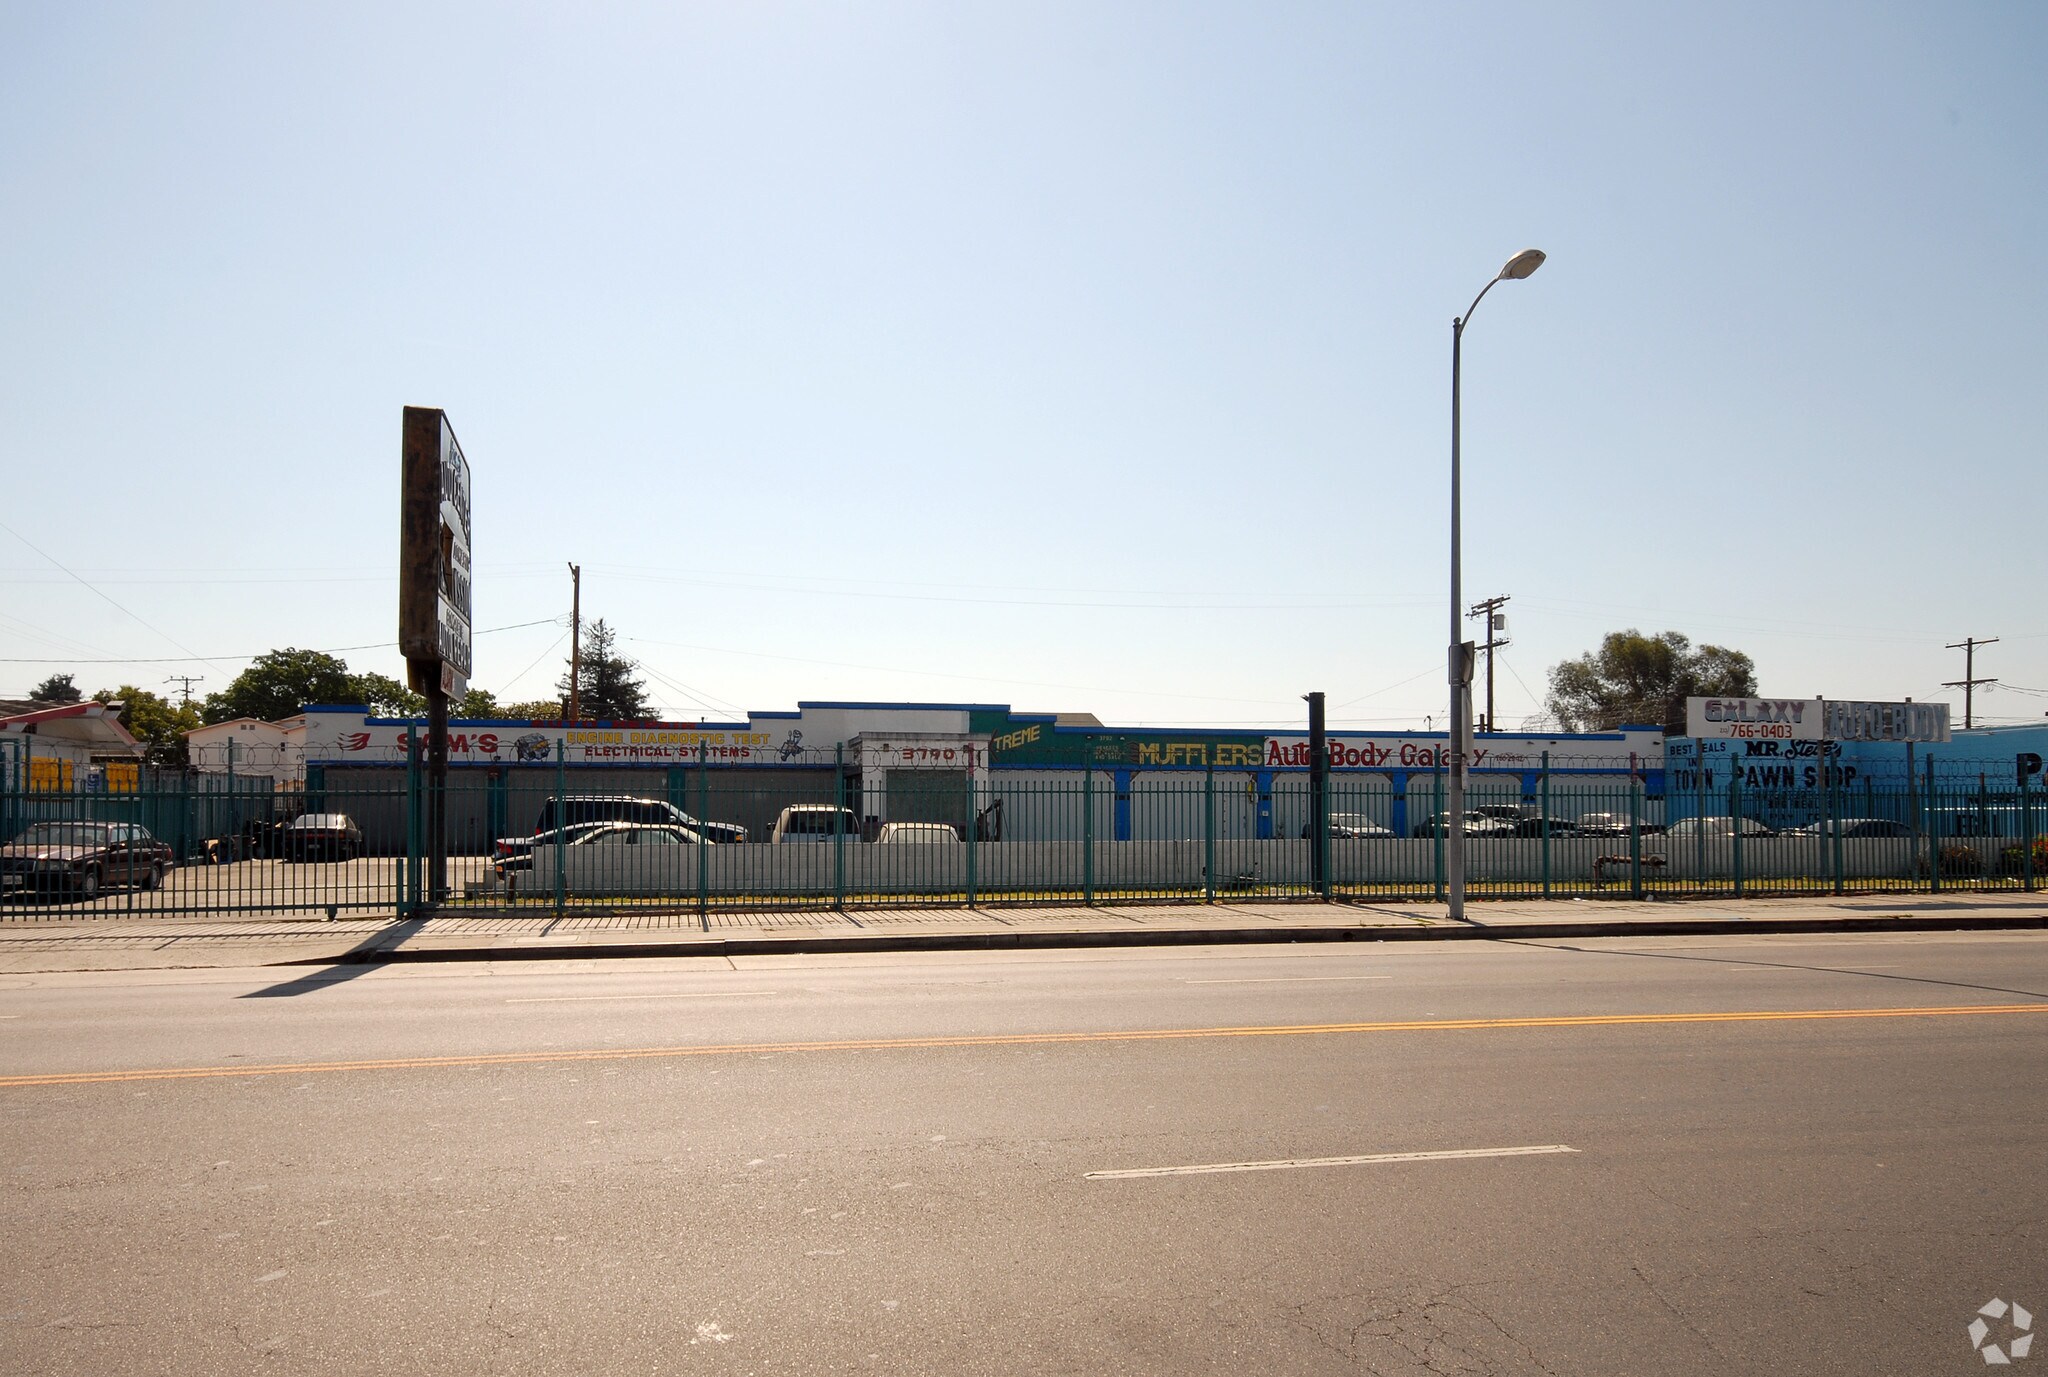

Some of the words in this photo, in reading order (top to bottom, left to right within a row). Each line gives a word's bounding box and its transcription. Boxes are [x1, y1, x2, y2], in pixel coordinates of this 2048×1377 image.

[1705, 700, 1804, 723] GALAXY
[1829, 703, 1883, 740] AUTO
[1892, 704, 1946, 740] BODY
[1730, 724, 1793, 738] 766-0403
[567, 732, 623, 744] ENGINE
[631, 732, 724, 744] DIAGNOSTIC
[731, 734, 771, 745] TEST
[585, 746, 671, 757] ELECTRICAL
[1327, 741, 1392, 766] Body
[1670, 744, 1692, 755] BEST
[1701, 742, 1726, 754] EALS
[1745, 741, 1783, 757] MR.
[1688, 758, 1697, 767] IN
